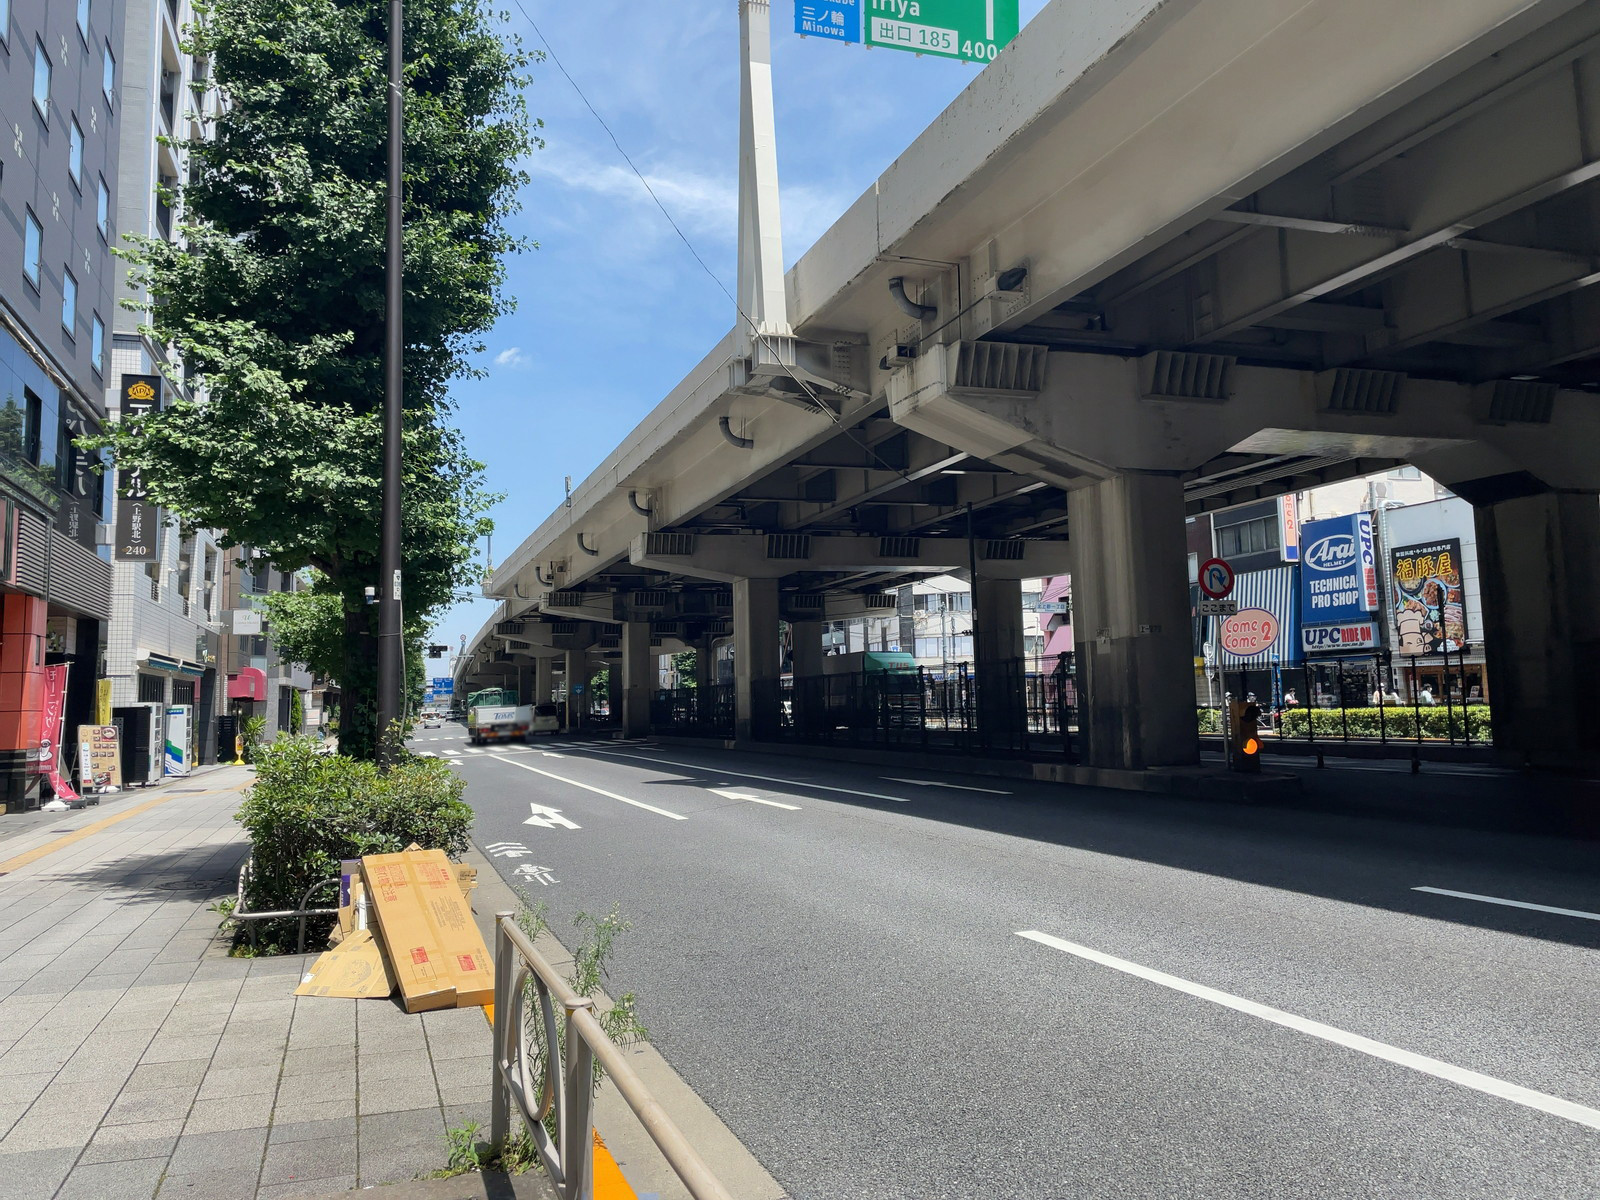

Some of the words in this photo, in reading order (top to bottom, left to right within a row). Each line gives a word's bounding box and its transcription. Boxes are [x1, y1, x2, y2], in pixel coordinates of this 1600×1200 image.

[802, 6, 845, 26] 三ノ輪
[802, 20, 845, 37] Minowa
[879, 22, 911, 43] 出口
[918, 29, 951, 49] 185
[962, 40, 998, 61] 400
[1287, 519, 1294, 530] 2
[126, 545, 147, 555] 240
[1309, 540, 1355, 563] Arai
[1359, 519, 1374, 565] UPC
[1323, 560, 1346, 568] HELMET
[1396, 552, 1452, 580] 福豚屋
[1202, 603, 1236, 613] ここまで
[1312, 594, 1332, 609] PRO
[1332, 591, 1358, 607] SHOP
[1226, 619, 1257, 634] Come
[1261, 621, 1271, 641] 2
[1304, 627, 1340, 646] UPC
[1340, 627, 1359, 643] RIDE
[1360, 626, 1372, 641] ON
[1225, 634, 1257, 649] Come
